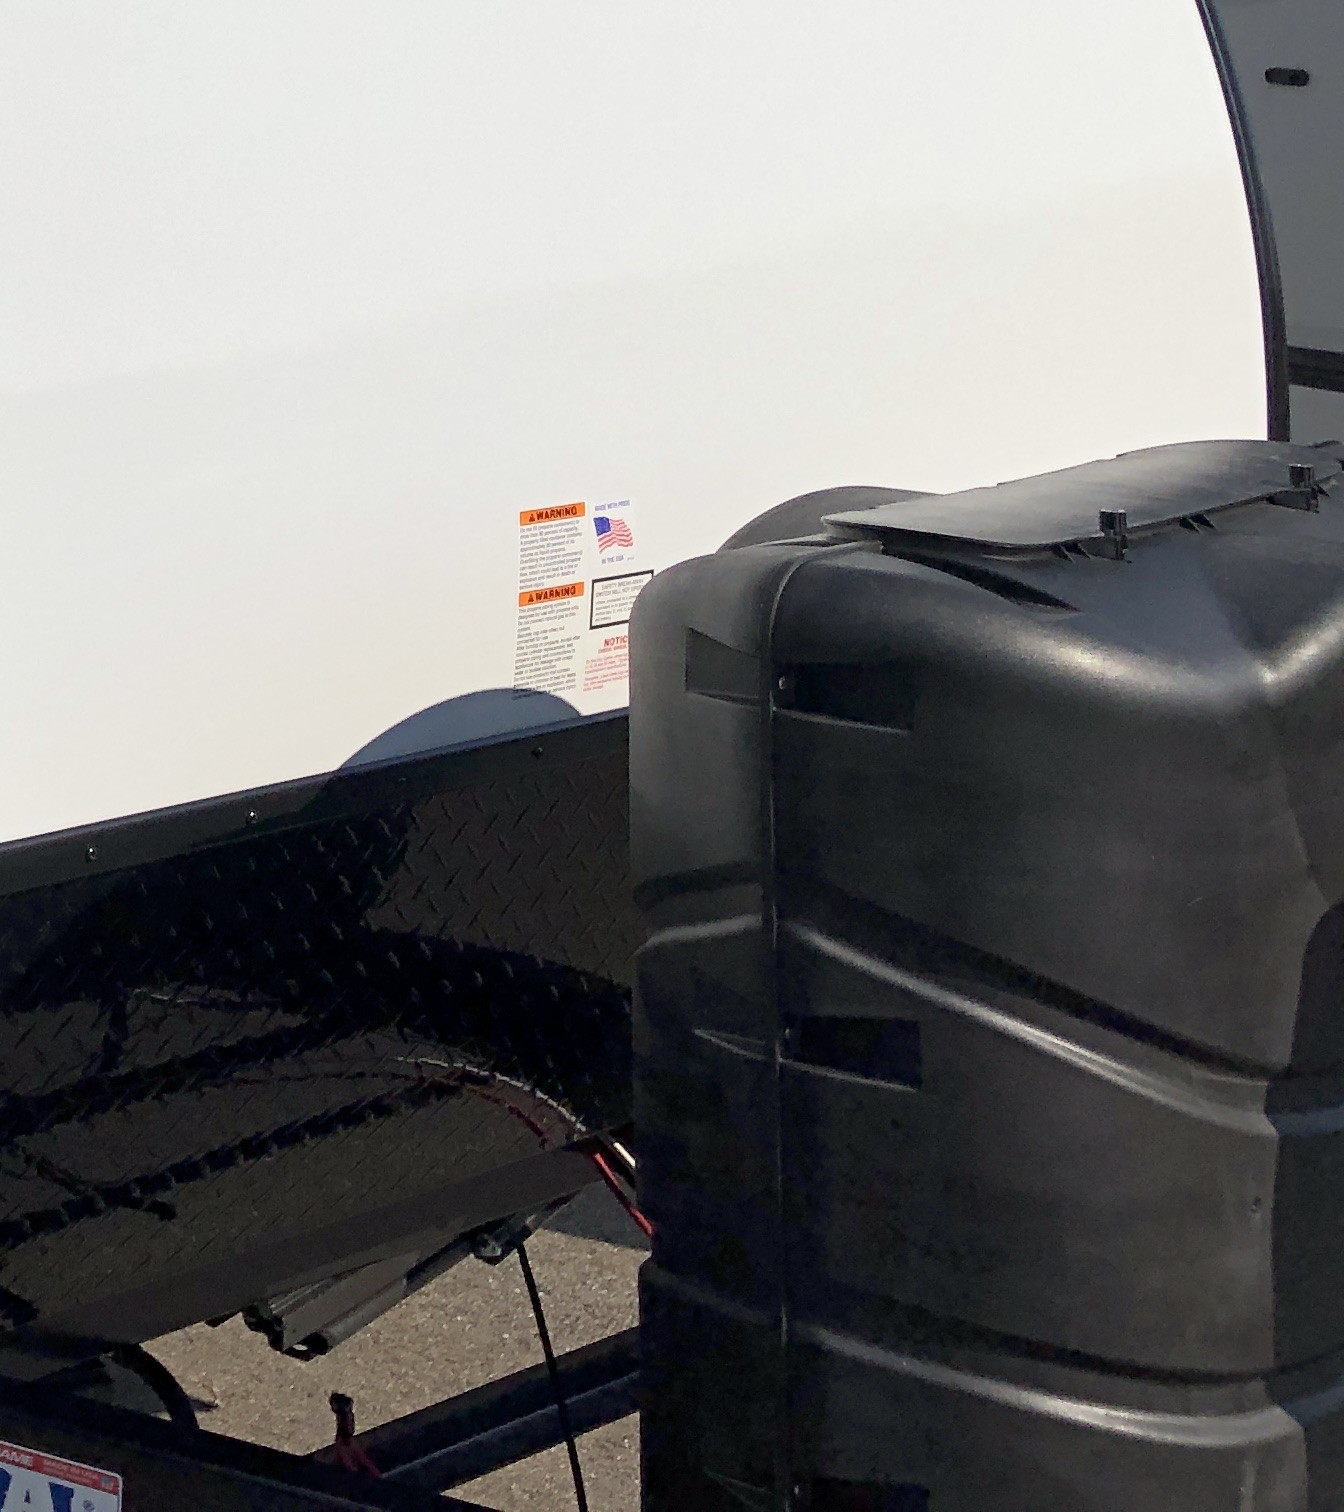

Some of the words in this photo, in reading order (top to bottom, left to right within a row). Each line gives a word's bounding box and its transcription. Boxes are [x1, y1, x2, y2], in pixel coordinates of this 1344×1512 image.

[536, 506, 578, 521] WARNING
[535, 586, 576, 601] WARNING
[603, 635, 628, 647] NOTIC
